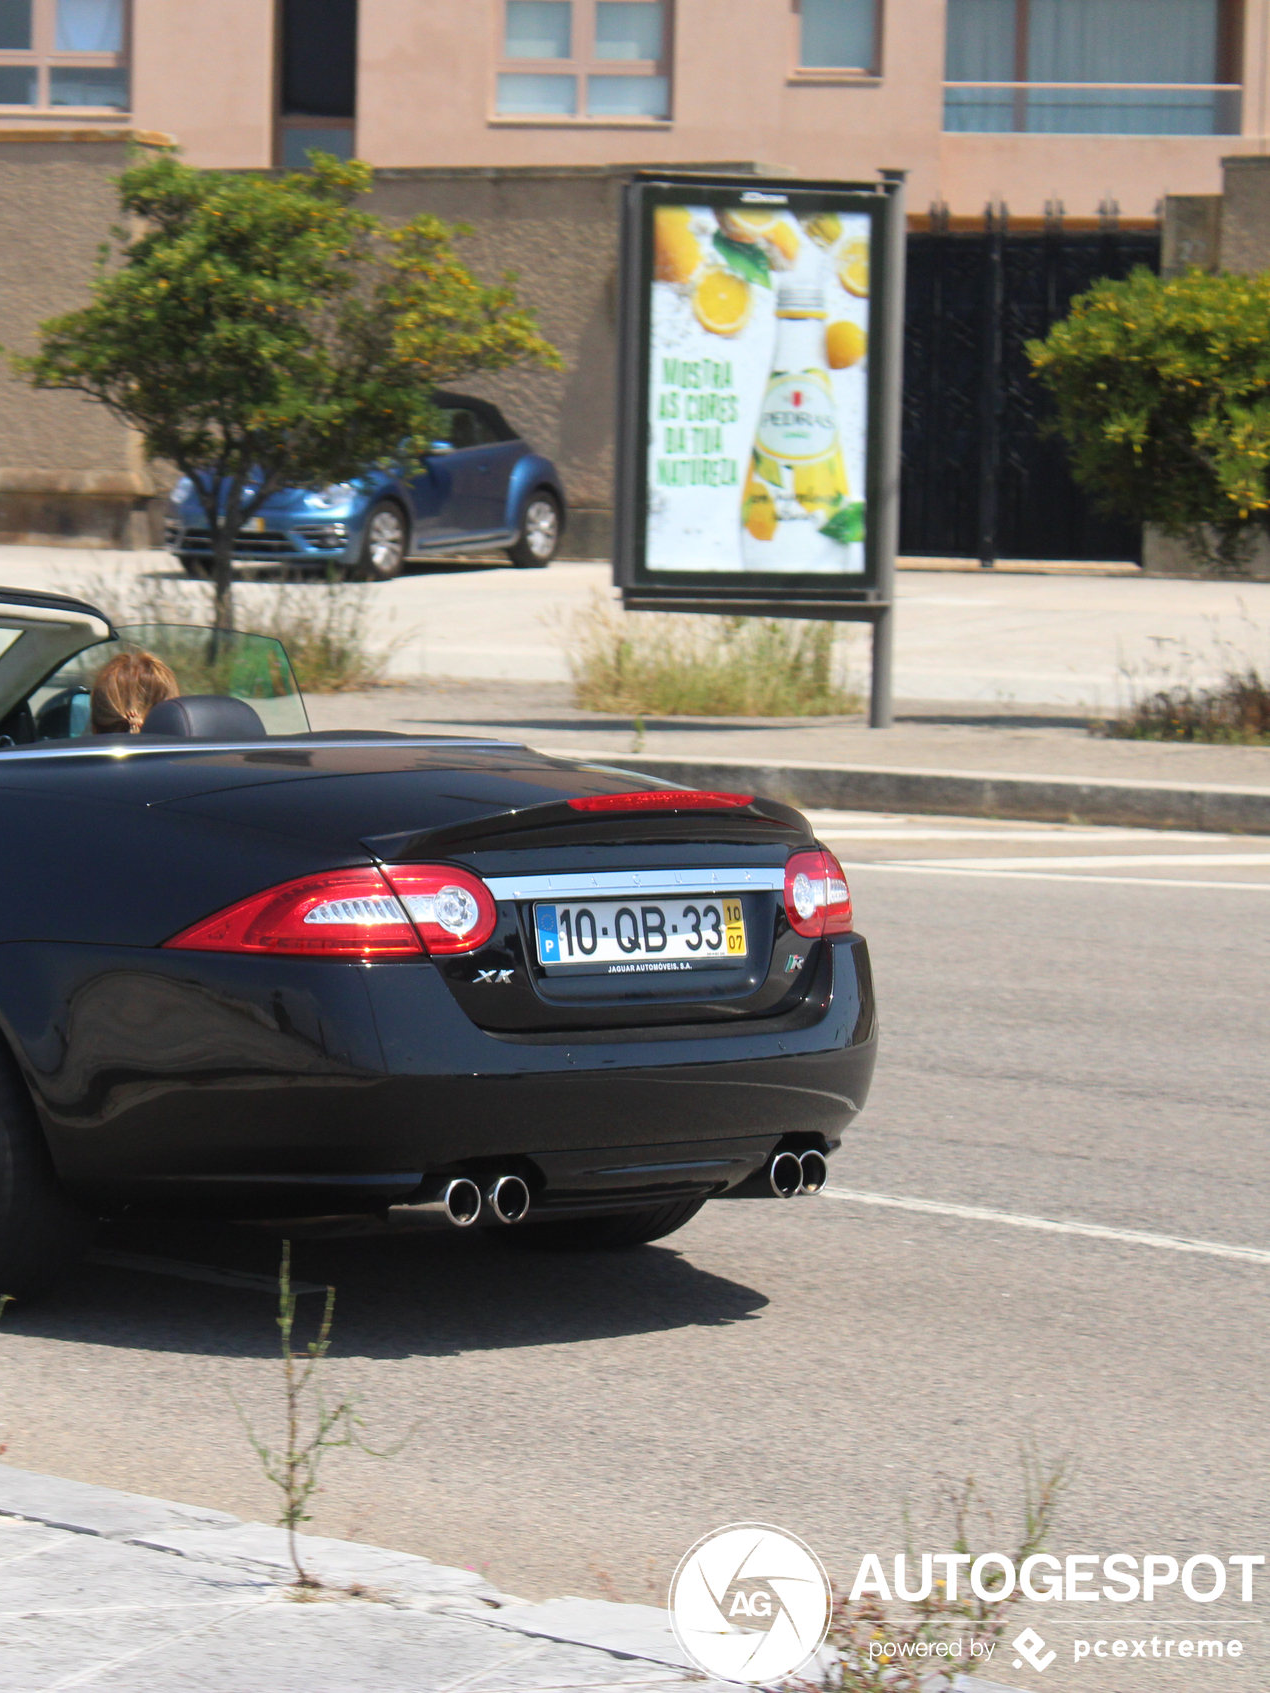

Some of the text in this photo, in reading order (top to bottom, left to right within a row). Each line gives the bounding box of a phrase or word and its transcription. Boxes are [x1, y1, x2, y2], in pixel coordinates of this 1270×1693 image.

[662, 357, 734, 389] MOSTRA
[657, 391, 739, 424] AS CORES
[760, 410, 835, 429] PEDRAS
[664, 426, 724, 454] DA TUA
[656, 457, 740, 487] NATUREZA
[726, 905, 742, 922] 10
[544, 939, 555, 954] P
[727, 934, 743, 950] 07
[472, 969, 515, 984] XK
[607, 964, 635, 974] JAGUAR
[679, 961, 693, 970] S.A.
